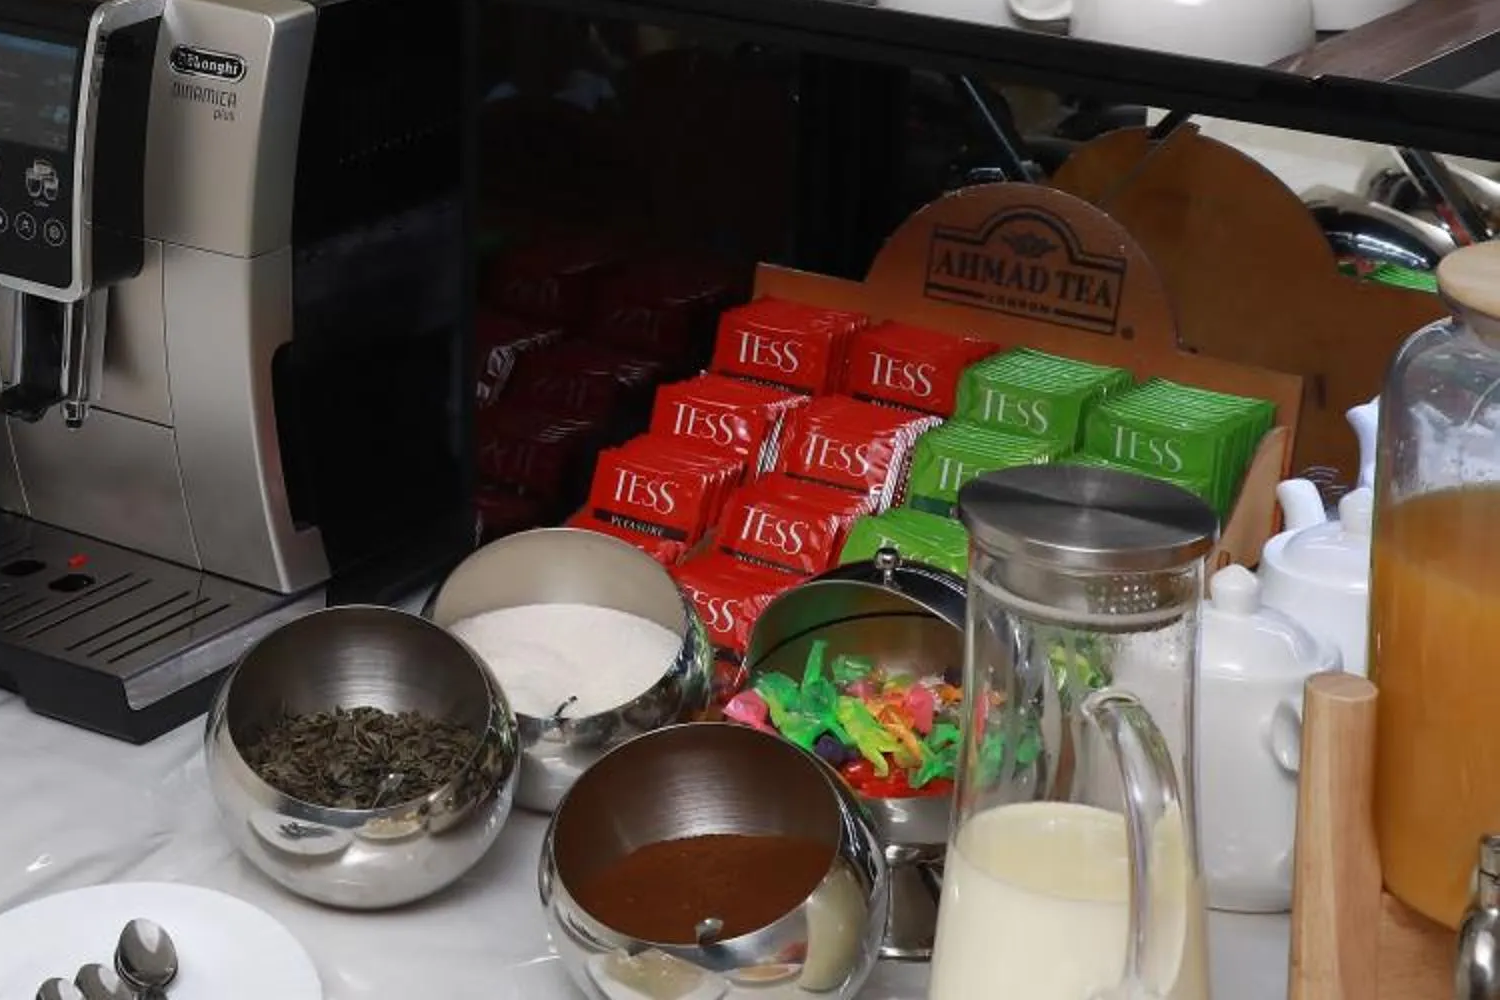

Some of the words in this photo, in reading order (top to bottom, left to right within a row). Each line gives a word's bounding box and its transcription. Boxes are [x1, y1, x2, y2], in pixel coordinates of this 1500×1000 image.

[932, 249, 1049, 293] AHMAD
[1055, 270, 1112, 308] TEA
[736, 330, 802, 374] TESS
[869, 352, 936, 397] TESS
[673, 402, 735, 446] TESS
[980, 388, 1051, 435] TESS
[804, 432, 870, 477] TESS
[1110, 424, 1186, 473] TESS
[614, 468, 677, 515] TESS
[740, 504, 806, 555] TESS
